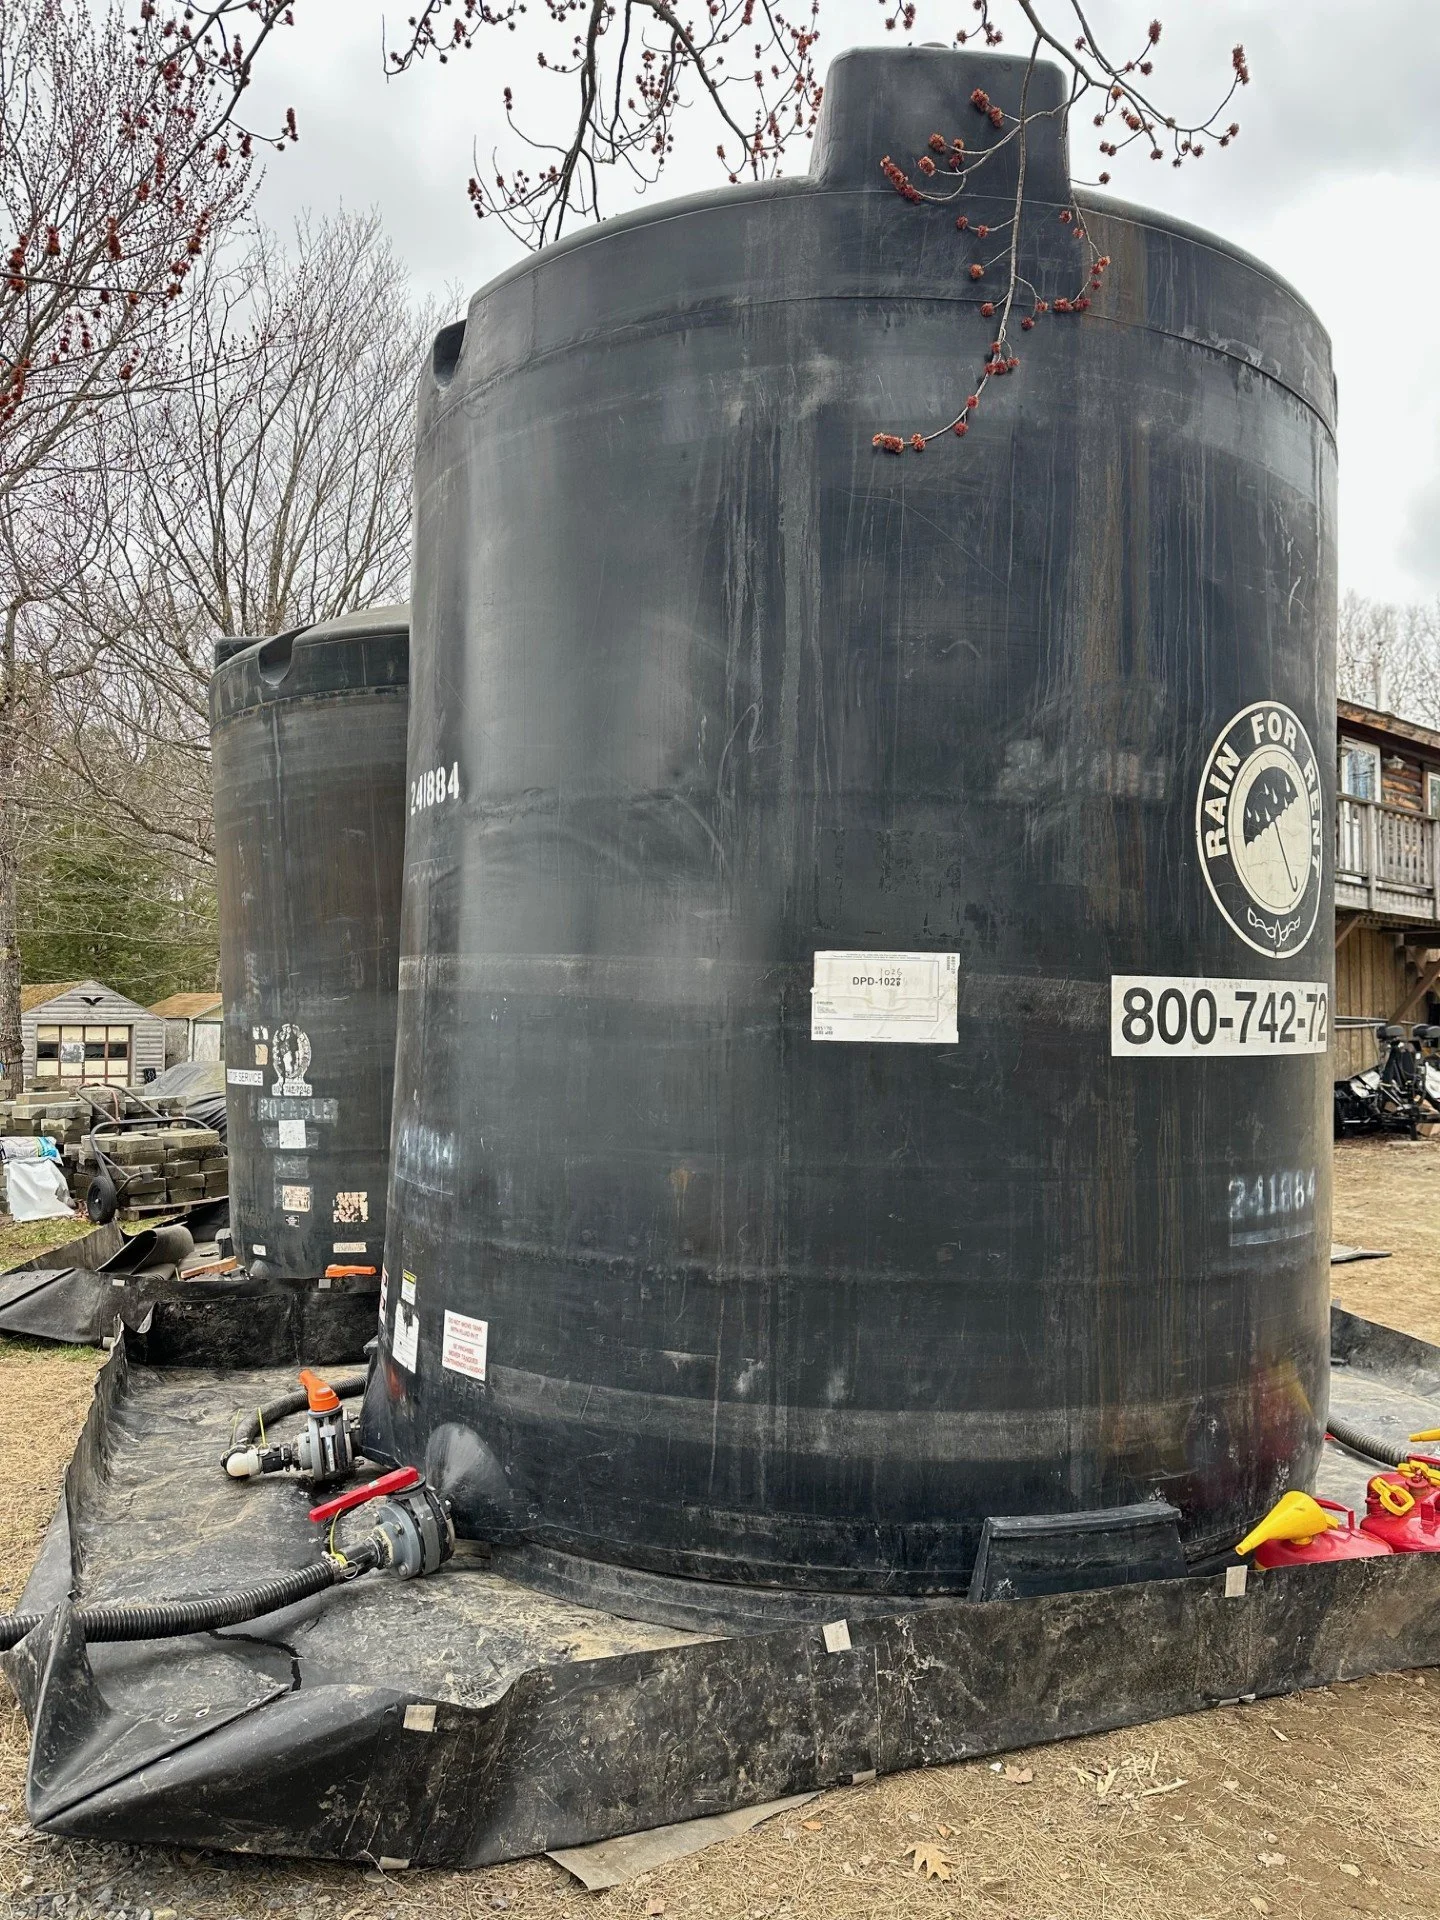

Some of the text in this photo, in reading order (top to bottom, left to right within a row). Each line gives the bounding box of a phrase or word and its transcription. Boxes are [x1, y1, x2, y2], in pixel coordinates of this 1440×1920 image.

[410, 761, 460, 816] 241884
[1204, 711, 1321, 879] RAIN FOR RENT
